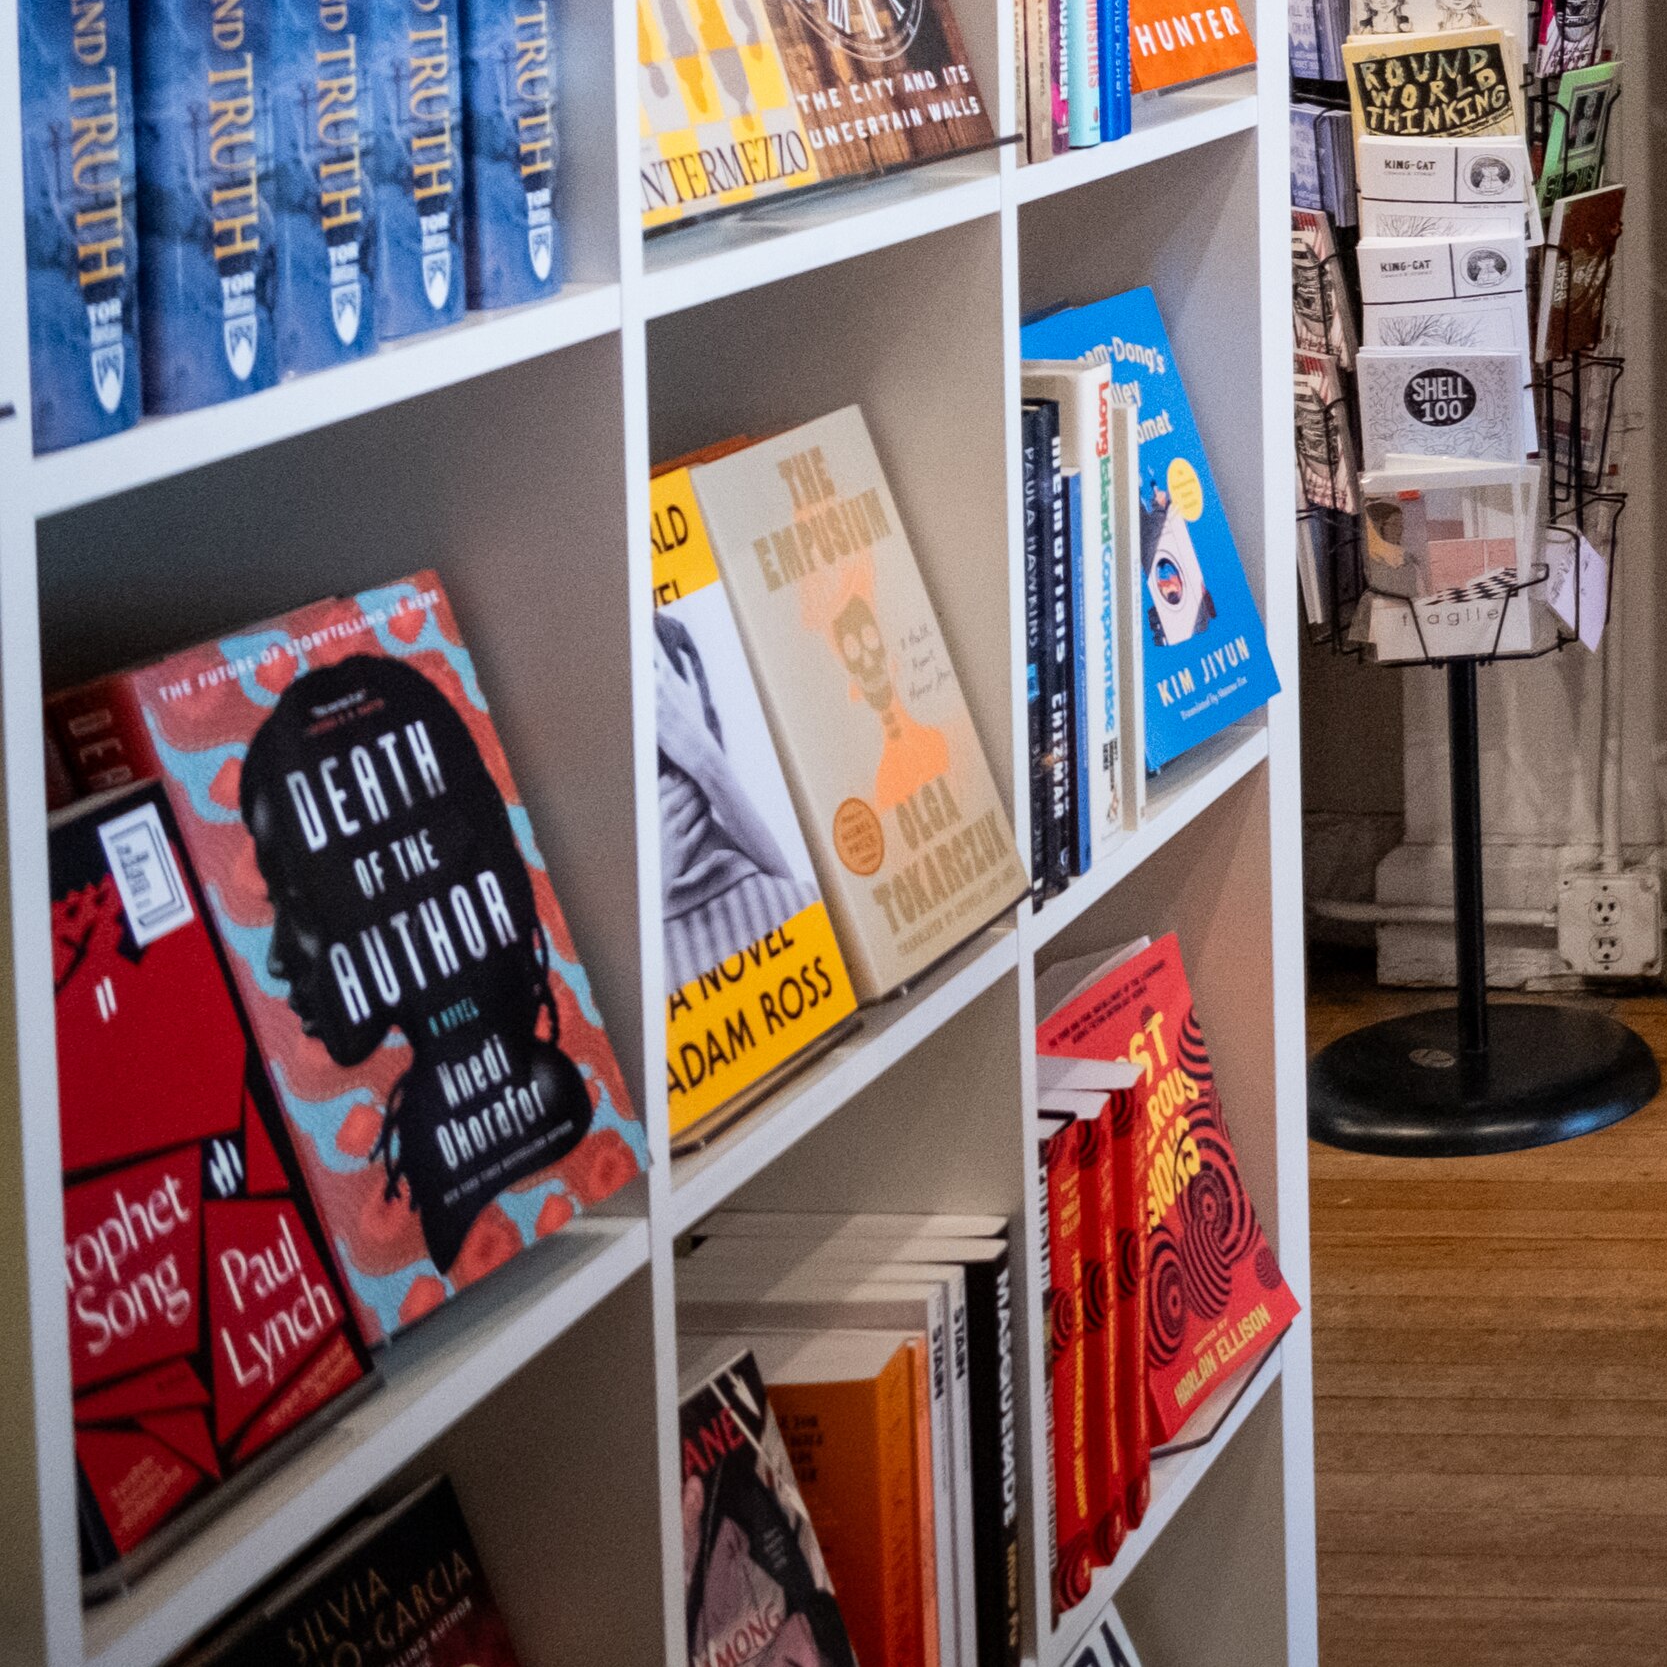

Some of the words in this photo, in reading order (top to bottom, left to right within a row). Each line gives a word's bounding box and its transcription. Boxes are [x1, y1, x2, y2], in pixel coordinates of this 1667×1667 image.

[1133, 7, 1240, 60] HUNTER
[1360, 47, 1491, 90] ROUND
[797, 87, 839, 115] THE
[849, 77, 897, 106] CITY
[904, 69, 936, 95] AND
[943, 65, 970, 87] ITS
[809, 110, 924, 151] UNCERTAIN
[929, 94, 981, 126] WALLS
[1366, 85, 1505, 134] THINKING
[1370, 69, 1496, 108] WORLD
[68, 68, 127, 289] TRUTH
[207, 54, 260, 262] TRUTH
[641, 129, 810, 213] NTERMEZZO
[1384, 158, 1437, 171] KING-CAT
[1380, 259, 1431, 273] KING-CAT
[1412, 377, 1467, 403] SHELL
[1421, 400, 1463, 423] 100
[778, 446, 836, 502] THE
[753, 488, 893, 593] EMPUSIUM
[159, 678, 192, 703] THE
[198, 656, 256, 691] FUTURE
[260, 645, 281, 667] OF
[286, 612, 388, 659] STORYTELLING
[392, 603, 408, 622] IS
[408, 589, 442, 617] HERE
[1157, 674, 1195, 708] KIM
[1201, 635, 1251, 688] JIYUN
[286, 719, 446, 852] DEATH
[1049, 693, 1064, 819] CHIZMAR
[895, 773, 959, 839] OLGA
[354, 855, 386, 900] OF
[388, 828, 441, 882] THE
[872, 809, 1015, 935] TOKARCZUK
[330, 870, 518, 1024] AUTHOR
[668, 980, 693, 1025] A
[699, 924, 796, 996] NOVEL
[436, 1034, 513, 1108] Nnedi
[666, 1014, 756, 1099] ADAM
[764, 954, 835, 1021] ROSS
[434, 1079, 548, 1172] Okorafor
[64, 1174, 191, 1291] rophet
[219, 1213, 304, 1314] Paul
[75, 1253, 192, 1355] Song
[219, 1273, 337, 1388] Lynch
[994, 1268, 1018, 1527] MASQUERADE
[1174, 1346, 1216, 1409] HARLAN
[1216, 1302, 1272, 1362] ELLISON
